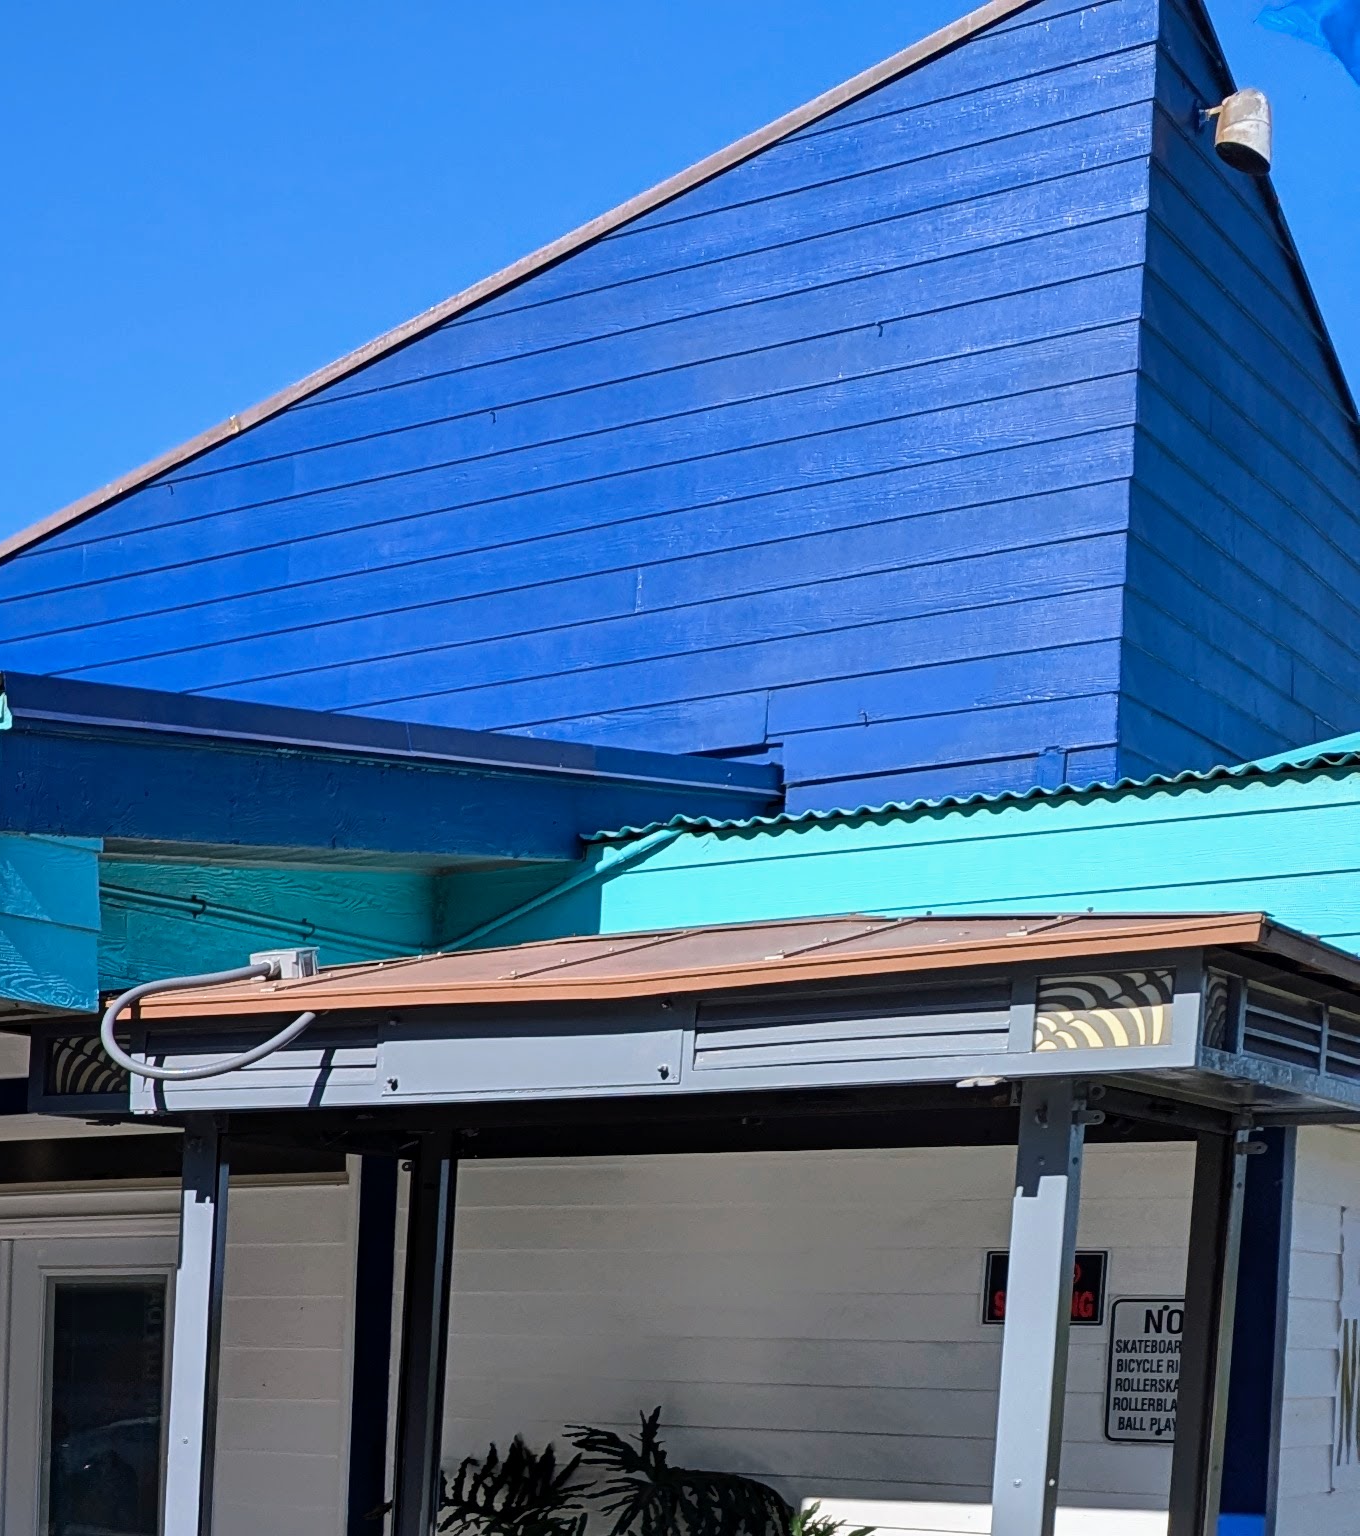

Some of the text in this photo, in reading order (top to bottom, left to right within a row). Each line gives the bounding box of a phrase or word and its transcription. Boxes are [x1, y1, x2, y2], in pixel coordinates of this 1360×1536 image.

[1144, 1309, 1184, 1334] NO
[1115, 1339, 1182, 1354] SKATEBOAR
[1116, 1359, 1163, 1373] BICYCLE
[1115, 1378, 1179, 1392] ROLLERSKA
[1112, 1397, 1177, 1412] ROLLERBLA
[1117, 1417, 1175, 1432] BALL PLAY
